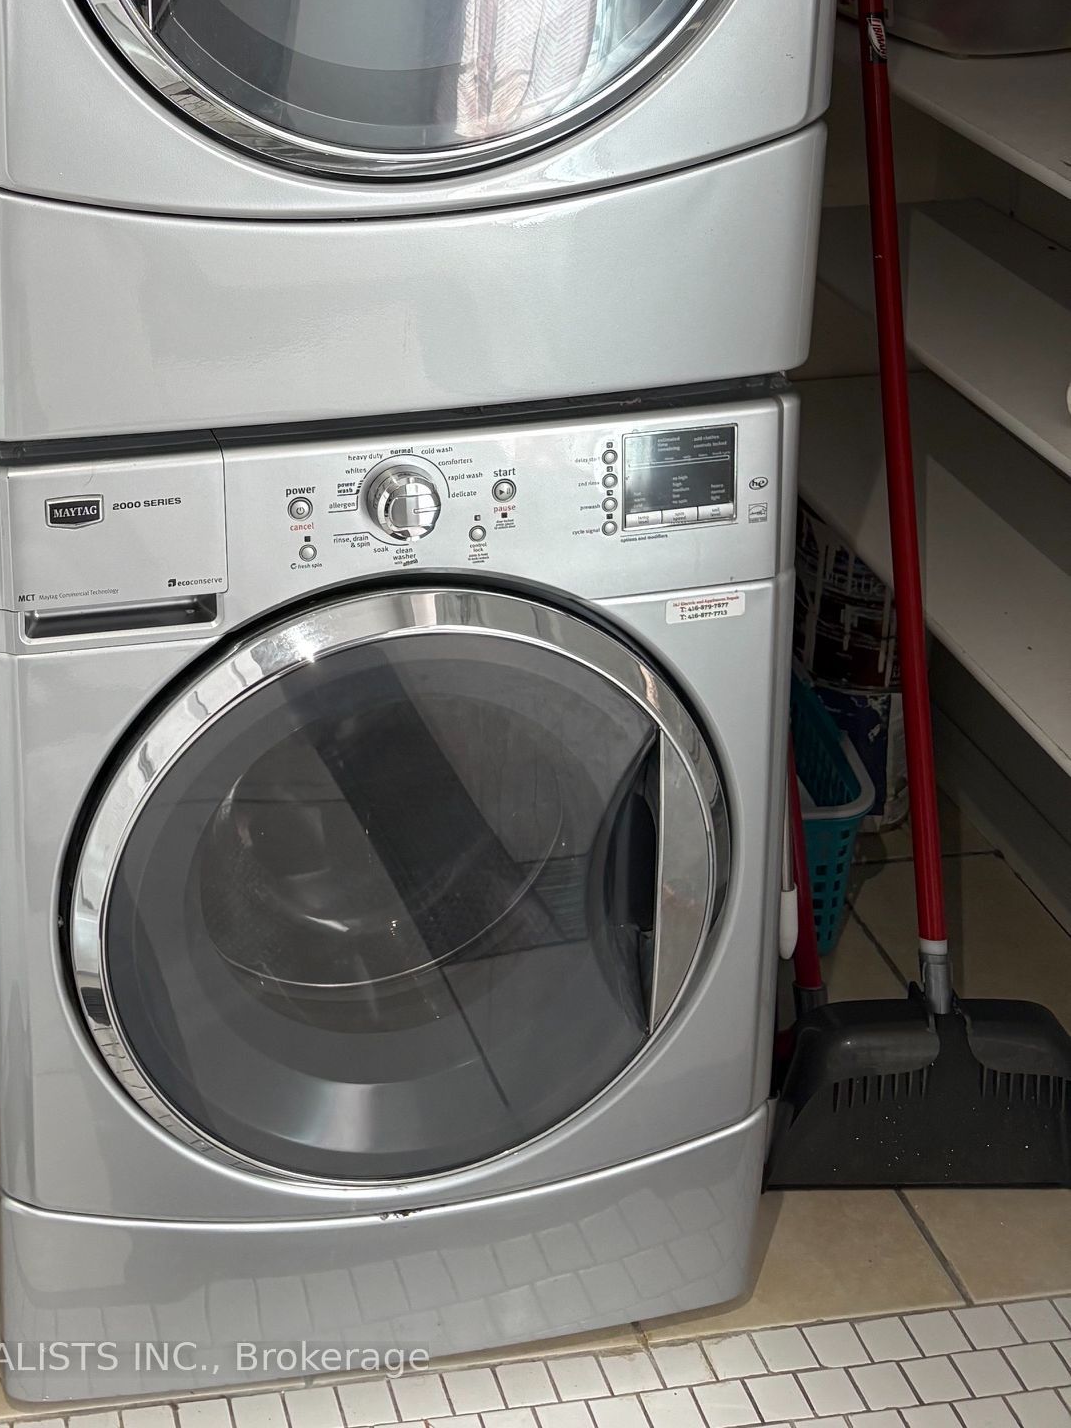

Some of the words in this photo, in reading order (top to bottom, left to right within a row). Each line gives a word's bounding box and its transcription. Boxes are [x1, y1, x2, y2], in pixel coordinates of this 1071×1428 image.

[348, 454, 367, 462] heavy
[368, 452, 383, 460] duty
[438, 457, 473, 466] comforters
[493, 467, 516, 477] start
[448, 473, 464, 481] rapid
[337, 481, 356, 489] power
[285, 485, 316, 497] power
[451, 490, 477, 498] delicate
[53, 505, 97, 518] MAYTAG
[112, 501, 141, 510] 2000
[143, 497, 182, 507] SERIES
[329, 501, 355, 510] allergen
[493, 504, 516, 513] pause
[290, 522, 315, 531] cancel
[333, 535, 351, 544] rinse,
[373, 546, 389, 554] soak
[393, 553, 416, 561] washer
[177, 577, 223, 587] ecoconserve
[18, 594, 35, 602] MCT
[39, 593, 58, 601] Maytag
[59, 590, 89, 599] Commercial
[90, 587, 119, 596] Technology
